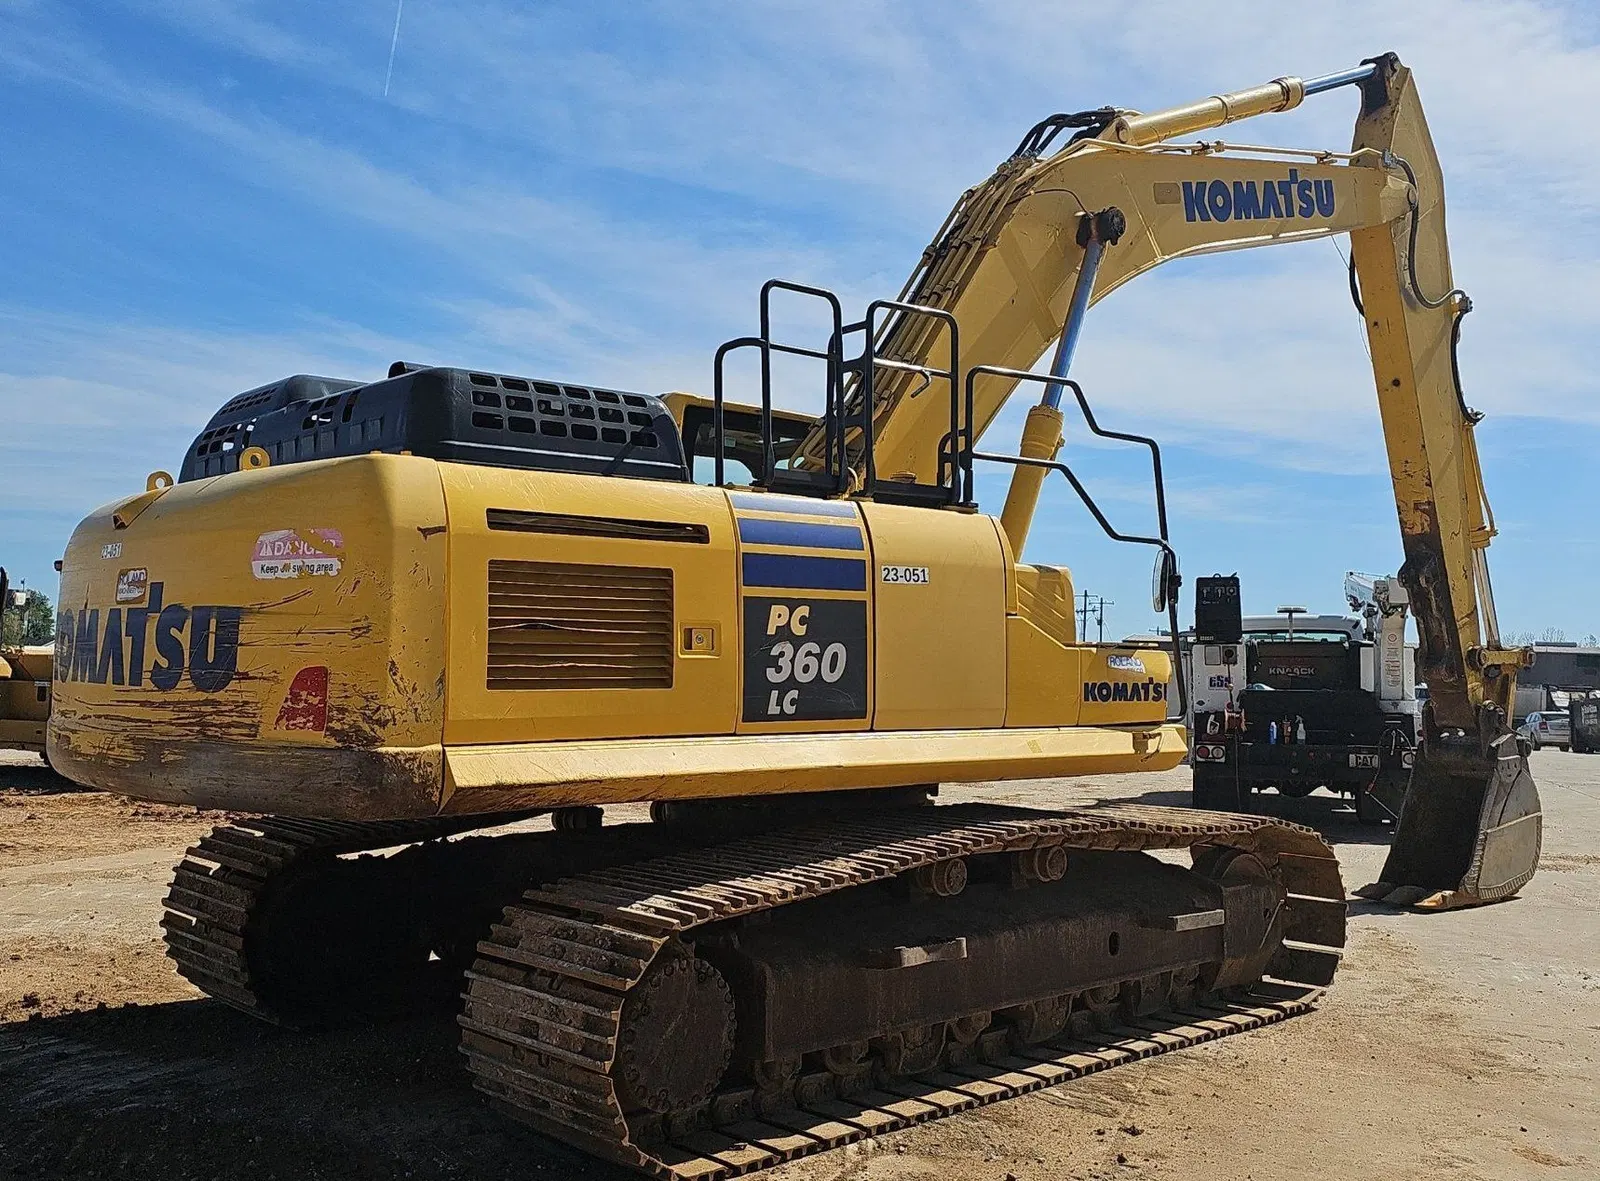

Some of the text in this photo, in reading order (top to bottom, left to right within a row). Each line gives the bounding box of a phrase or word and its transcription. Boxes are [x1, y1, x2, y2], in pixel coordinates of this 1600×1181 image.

[1182, 168, 1335, 223] KOMATSU
[274, 539, 336, 556] DANG
[260, 563, 279, 575] Keep
[316, 563, 334, 573] area
[882, 566, 928, 583] 23-051
[766, 604, 810, 636] PC
[766, 641, 847, 684] 360
[767, 689, 799, 715] LC
